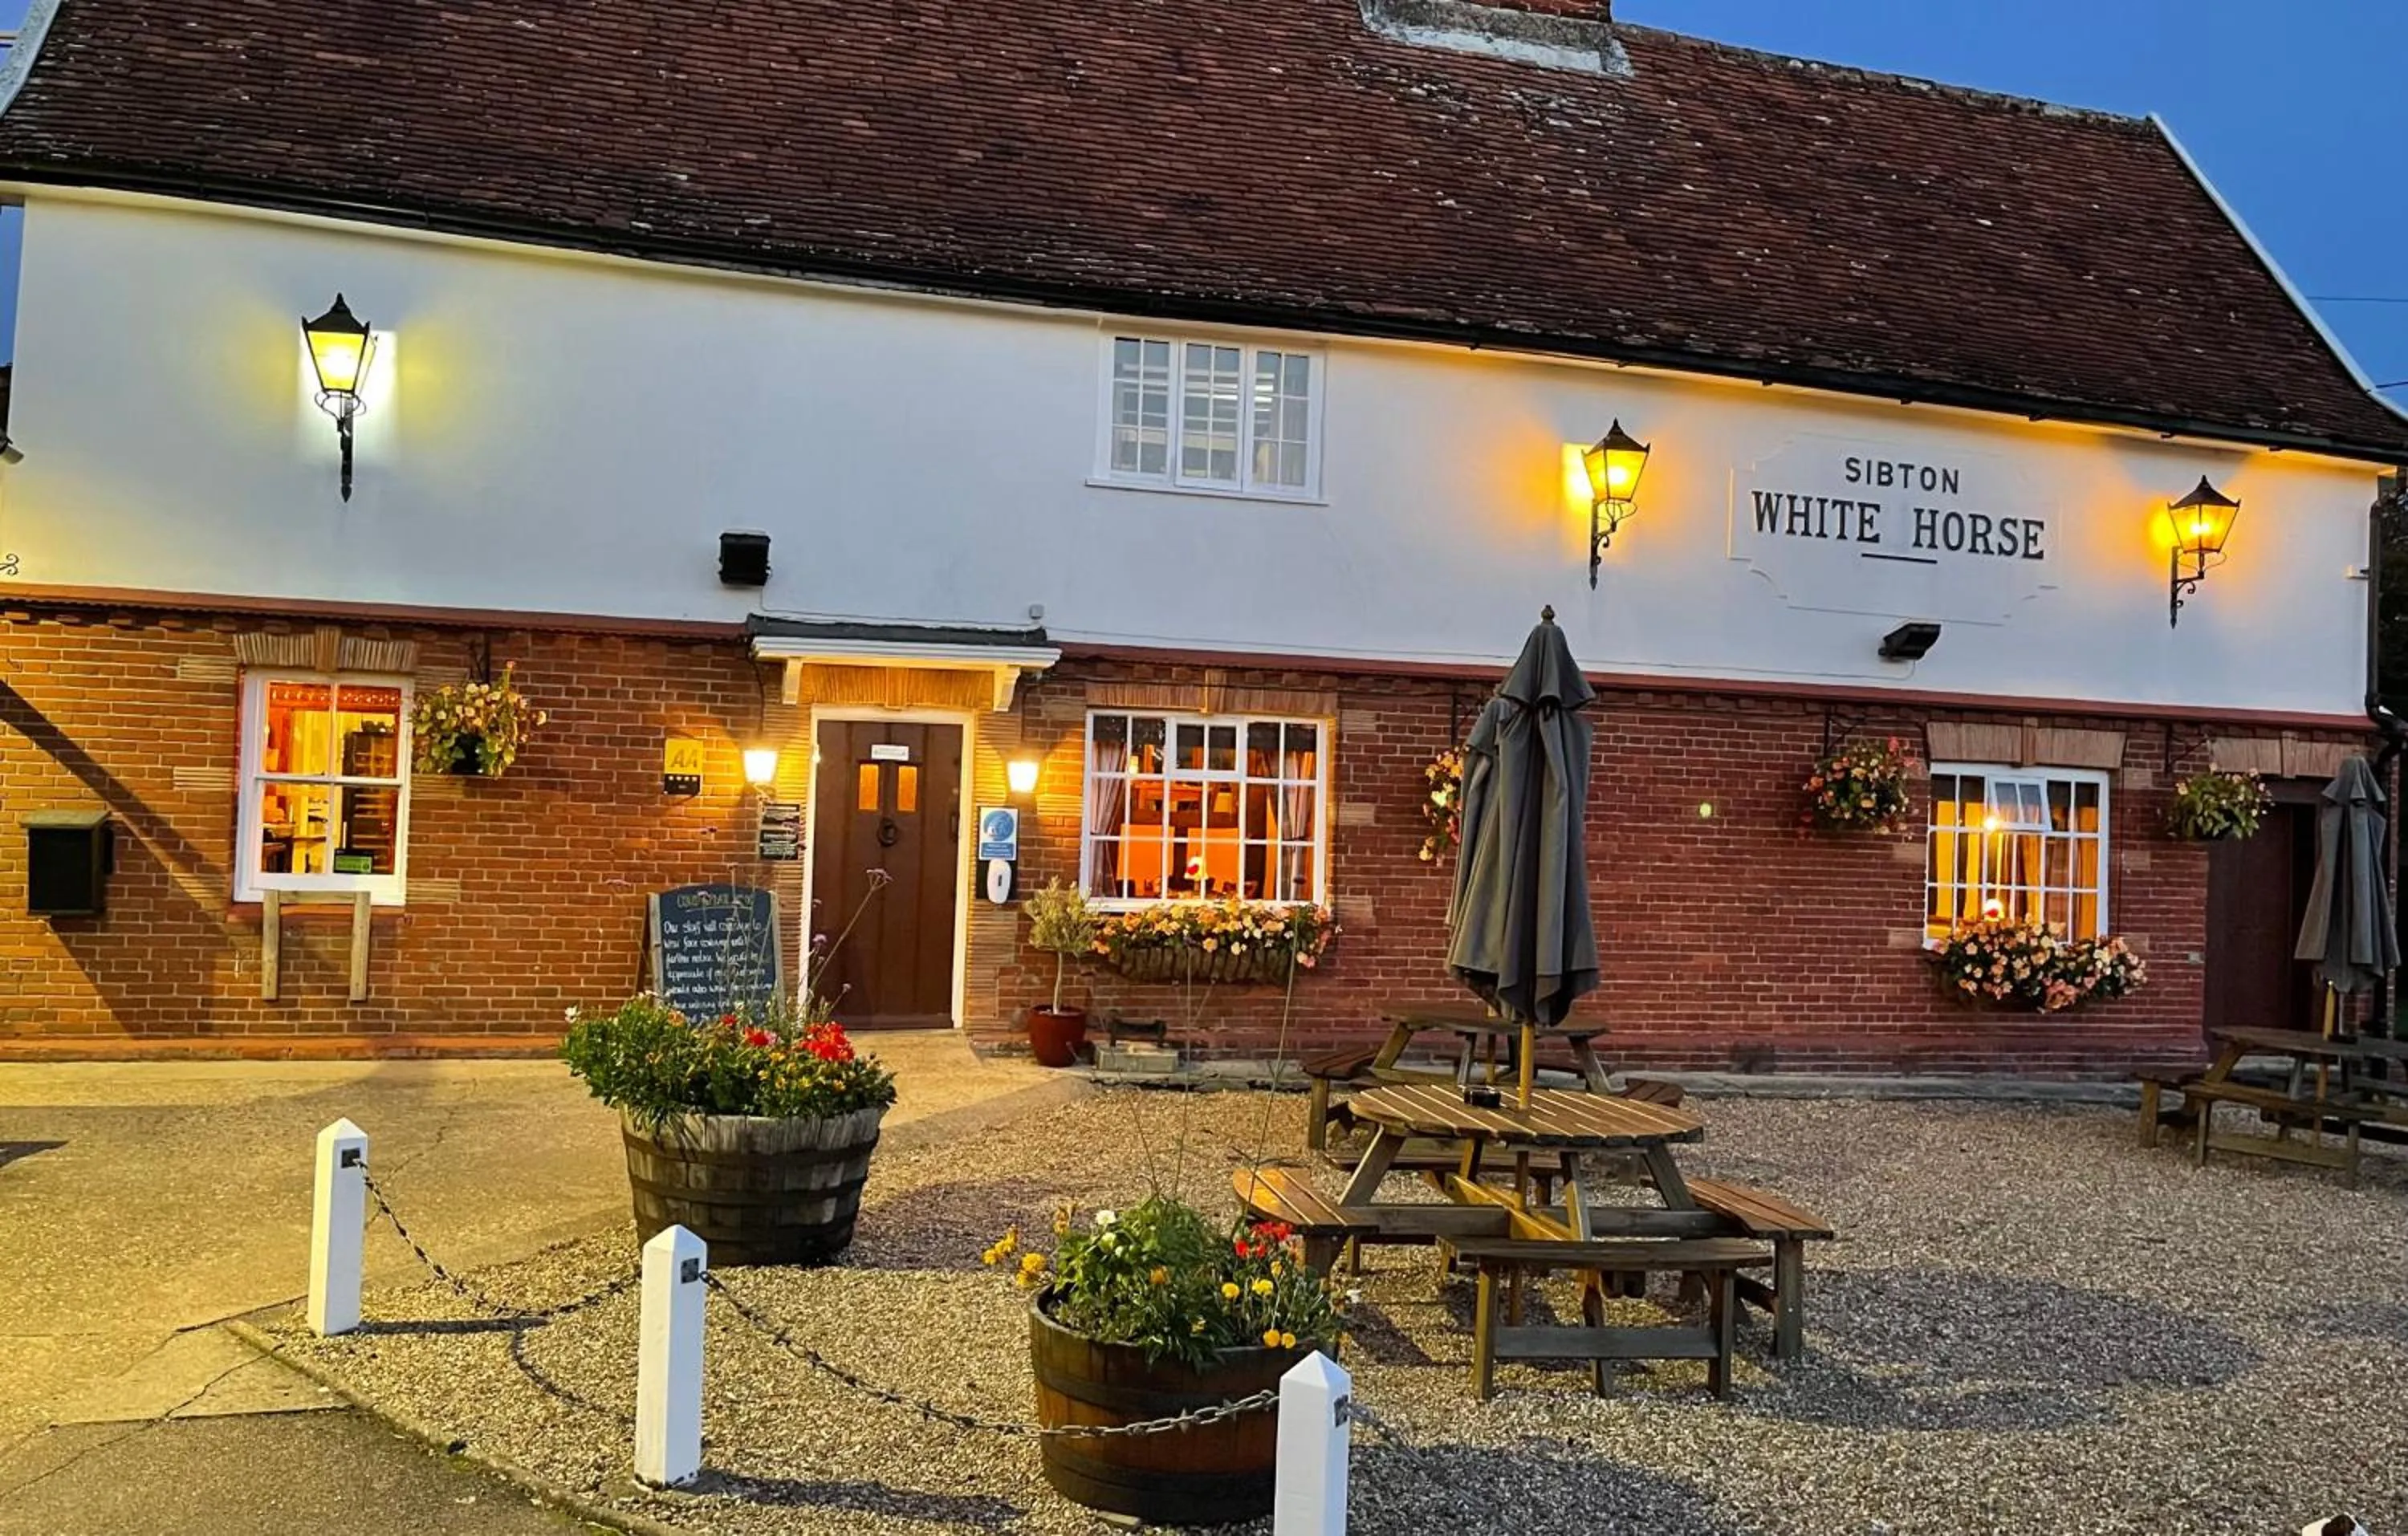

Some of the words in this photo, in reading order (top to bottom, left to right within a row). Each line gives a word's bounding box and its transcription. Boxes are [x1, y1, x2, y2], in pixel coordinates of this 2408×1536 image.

[1845, 457, 1959, 494] SIBTON
[1751, 490, 1881, 544] WHITE
[1912, 507, 2045, 560] HORSE
[669, 748, 698, 768] AA
